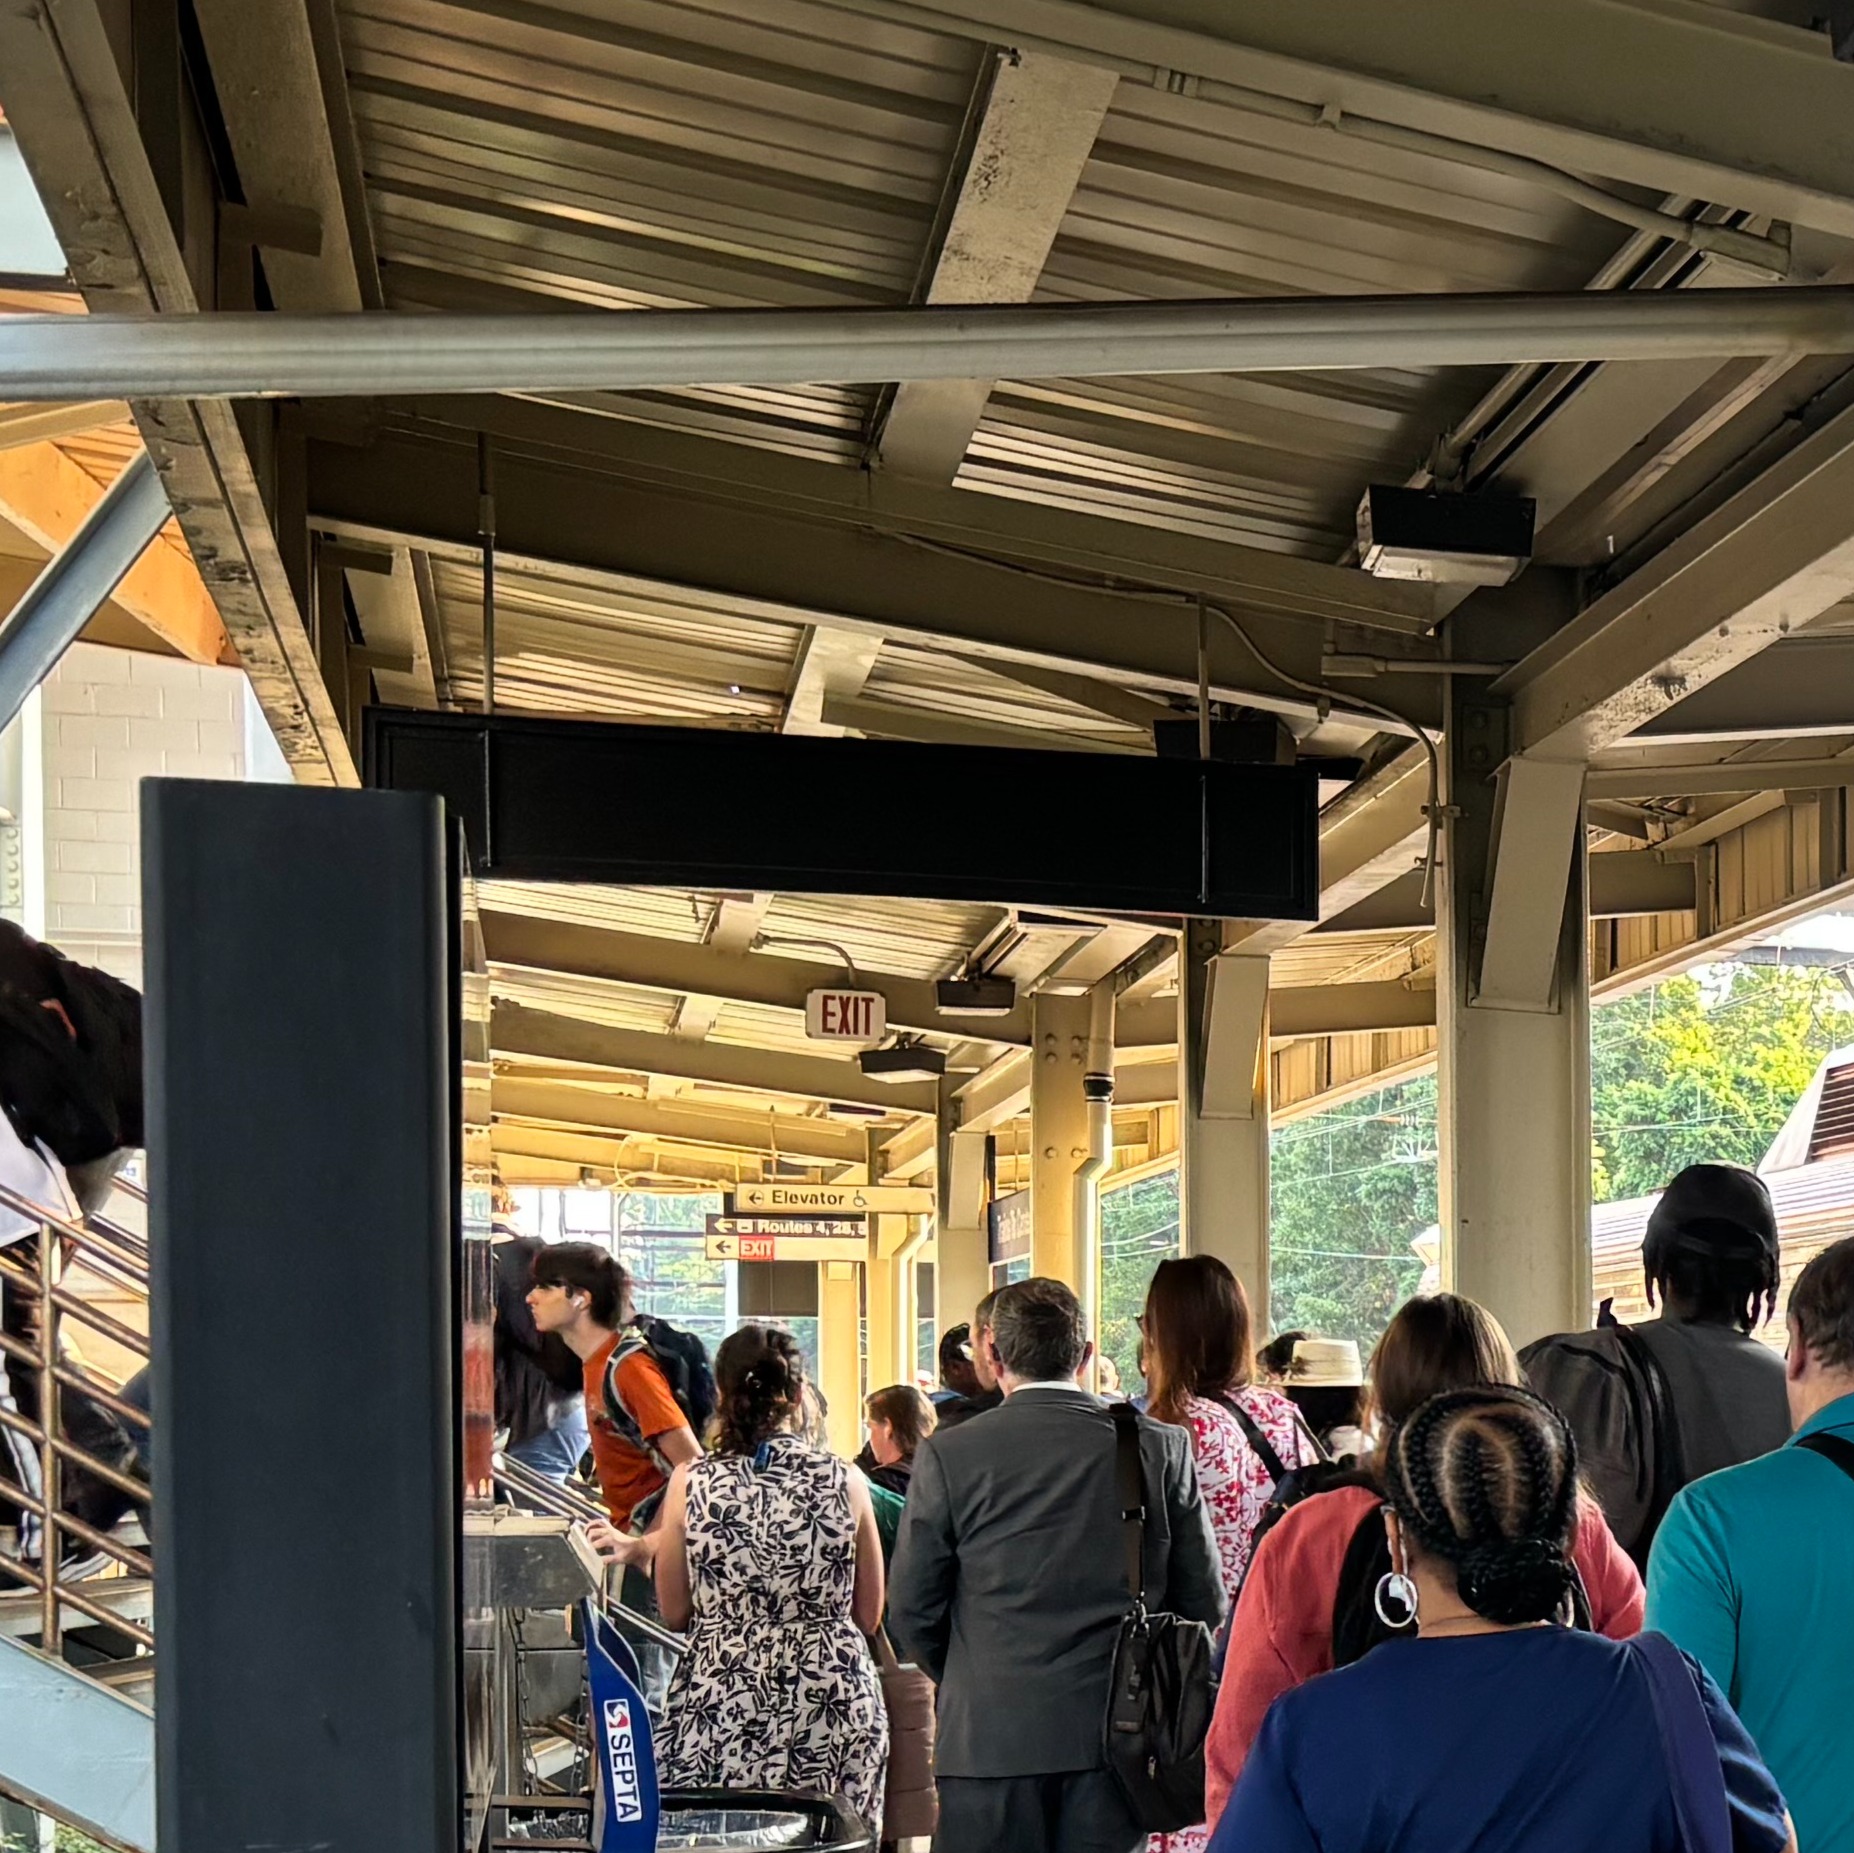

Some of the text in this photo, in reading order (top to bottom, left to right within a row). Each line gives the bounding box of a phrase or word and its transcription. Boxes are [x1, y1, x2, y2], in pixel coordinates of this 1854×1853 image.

[822, 994, 875, 1036] EXIT
[772, 1189, 845, 1206] Elevator
[757, 1219, 813, 1235] Routes
[740, 1240, 773, 1257] EXIT
[610, 1733, 639, 1819] SEPTA
